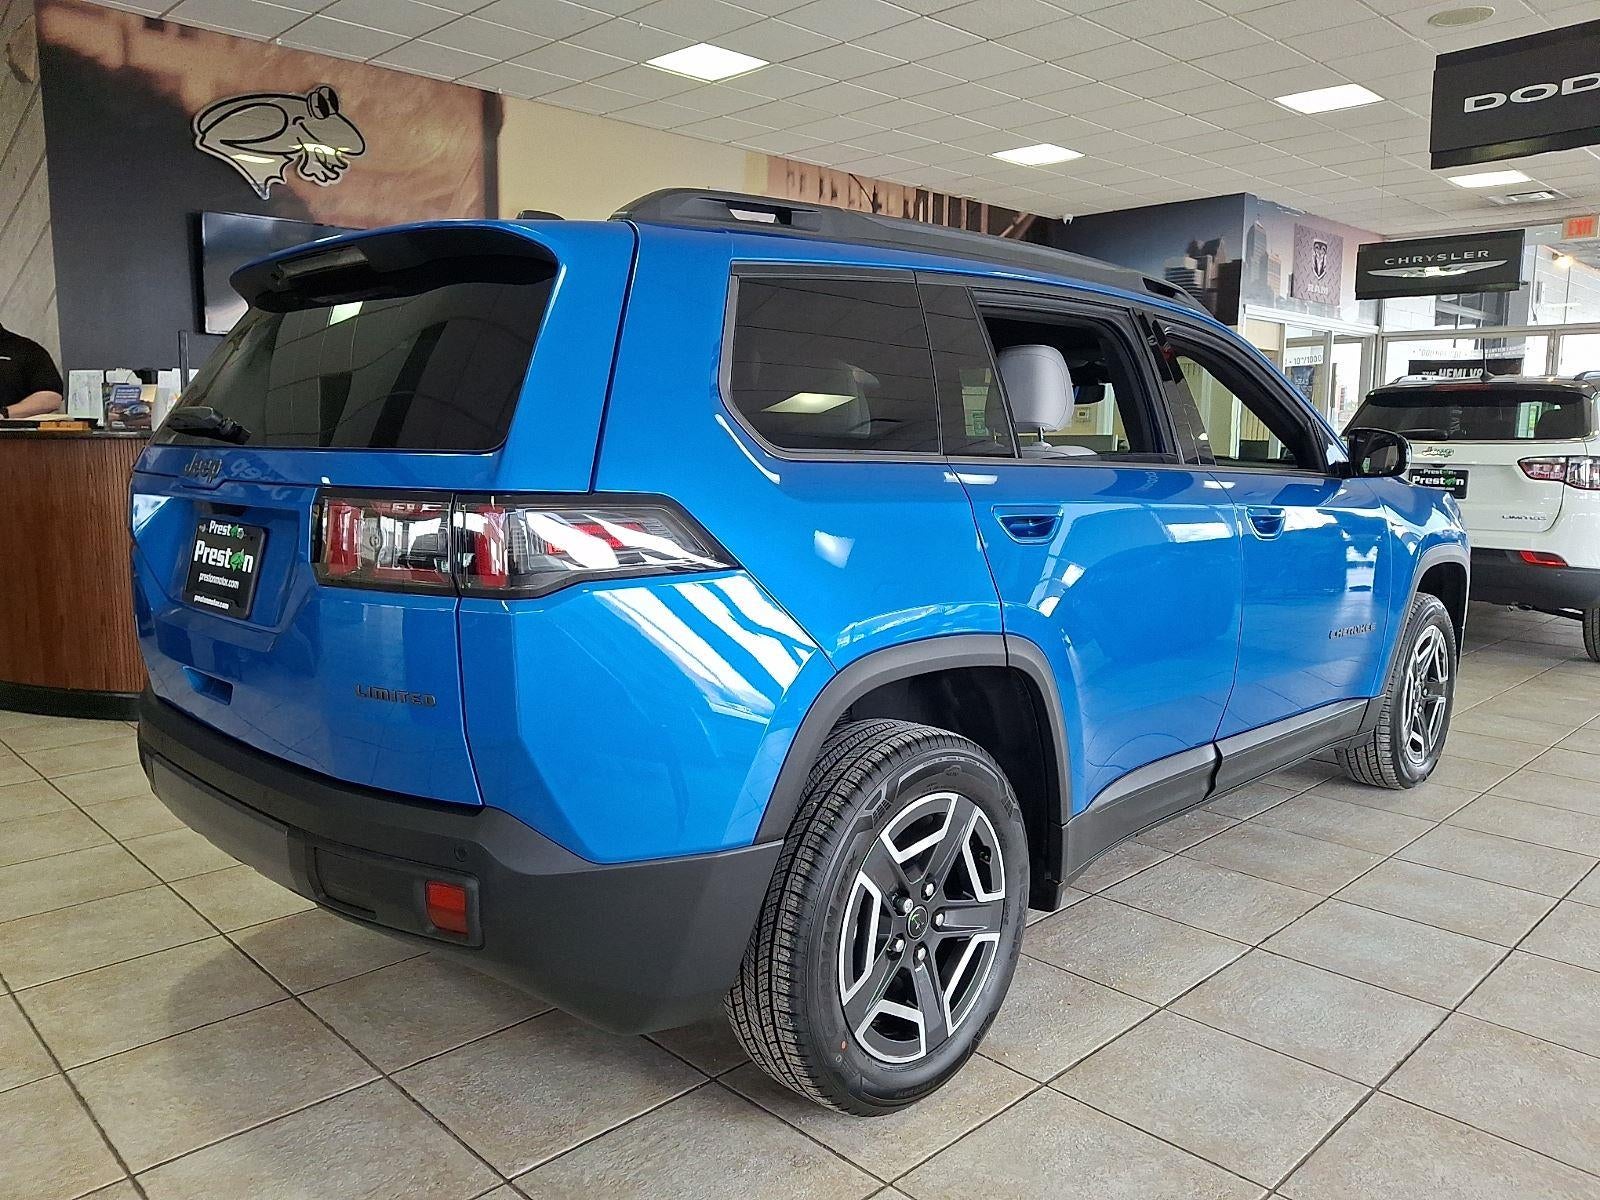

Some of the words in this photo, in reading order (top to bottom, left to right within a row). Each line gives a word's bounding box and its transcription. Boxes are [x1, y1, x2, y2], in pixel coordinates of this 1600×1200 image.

[1464, 72, 1600, 113] DOD
[1384, 250, 1489, 265] CHRYSLER
[1308, 284, 1328, 295] RAM
[185, 452, 222, 483] Jeep
[194, 540, 254, 573] Preston
[355, 683, 437, 706] LIMITED
